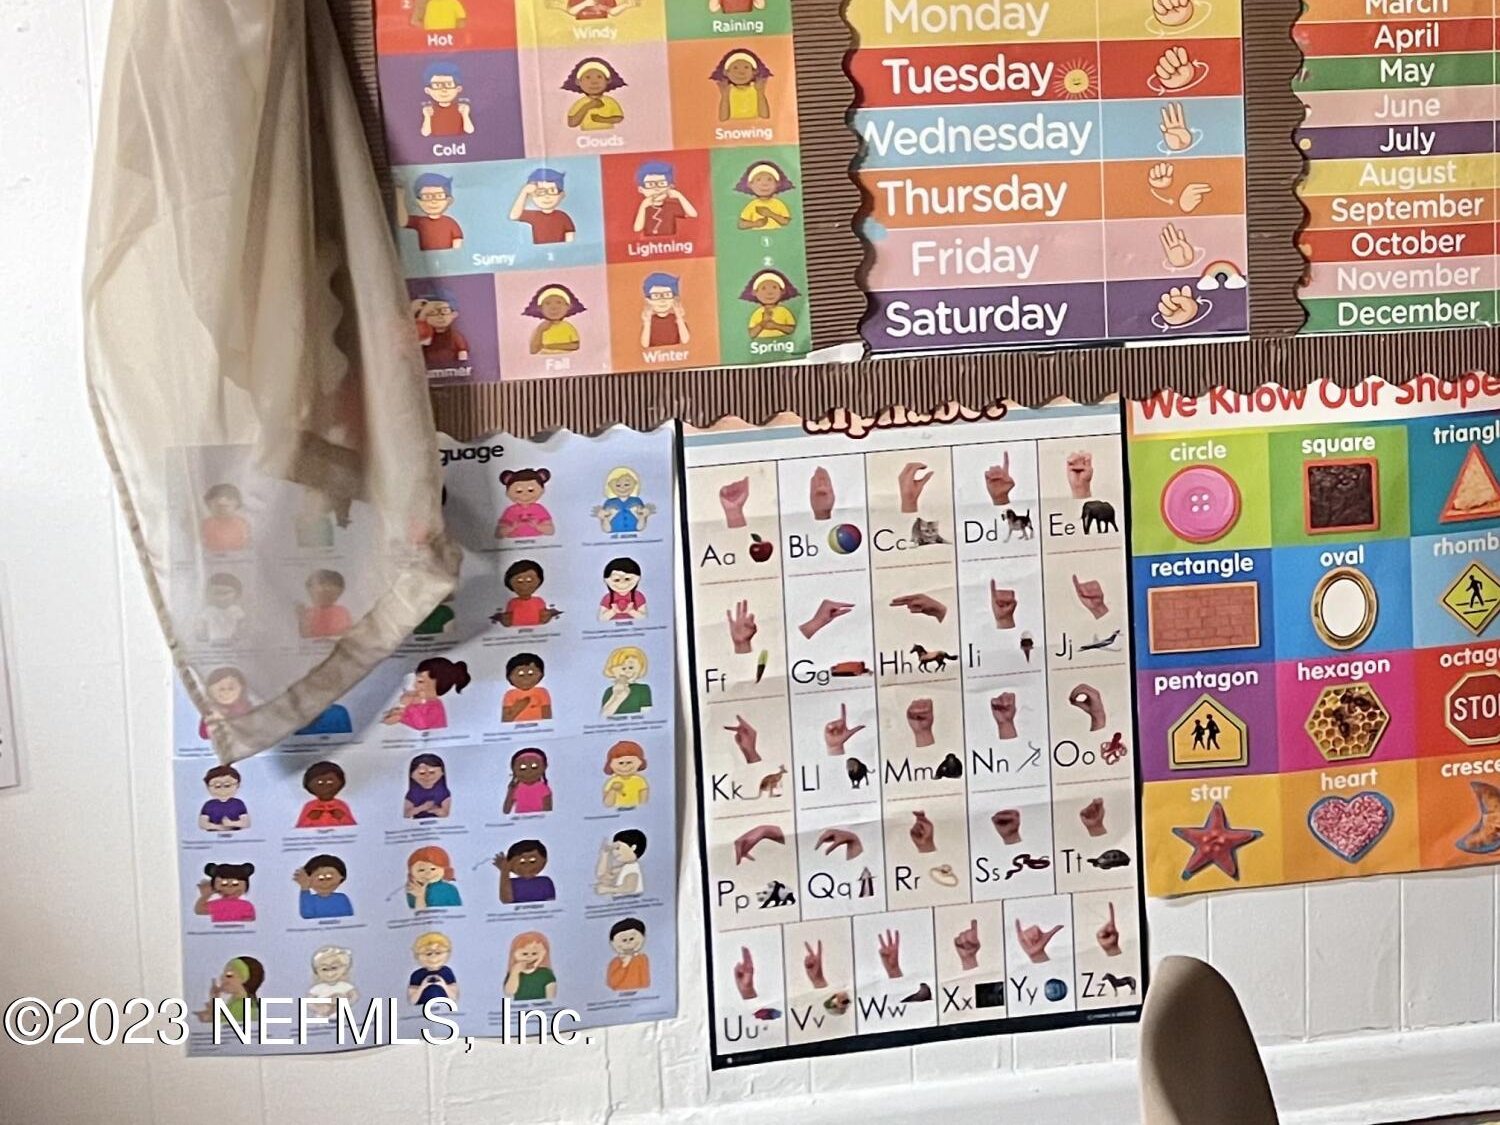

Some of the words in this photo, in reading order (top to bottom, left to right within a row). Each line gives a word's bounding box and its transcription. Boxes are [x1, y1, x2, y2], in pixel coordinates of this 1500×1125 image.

[572, 25, 617, 41] Windy
[712, 18, 763, 34] Raining
[427, 33, 453, 47] Hot
[1374, 23, 1439, 54] April
[882, 54, 1054, 97] Tuesday
[1380, 60, 1435, 86] May
[1375, 95, 1440, 119] June
[577, 134, 624, 149] Clouds
[715, 126, 773, 142] Snowing
[864, 113, 1092, 156] Wednesday
[1380, 128, 1435, 154] July
[432, 143, 466, 156] Cold
[1359, 162, 1456, 188] August
[877, 175, 1067, 216] Thursday
[1331, 195, 1483, 226] September
[628, 240, 693, 256] Lightning
[1351, 231, 1465, 257] October
[472, 252, 514, 267] Sunny
[912, 238, 1039, 276] Friday
[1337, 266, 1480, 291] November
[885, 297, 1067, 336] Saturday
[1338, 298, 1480, 327] December
[642, 348, 689, 363] Winter
[750, 339, 794, 355] Spring
[545, 357, 570, 370] Fall
[1140, 390, 1197, 421] We
[1209, 388, 1304, 415] Know
[1319, 379, 1383, 410] Our
[1170, 442, 1227, 461] circle
[1302, 435, 1376, 456] square
[964, 520, 997, 543] Dd
[1049, 514, 1075, 536] Ee
[790, 535, 818, 558] Bb
[874, 530, 907, 552] Cc
[701, 546, 735, 568] Aa
[1151, 554, 1253, 577] rectangle
[1320, 546, 1364, 567] oval
[968, 644, 981, 668] Ii
[1055, 633, 1073, 660] Jj
[791, 660, 829, 686] Gg
[880, 653, 912, 675] Hh
[1297, 658, 1390, 681] hexagon
[705, 668, 726, 692] Ff
[1155, 668, 1259, 695] pentagon
[972, 749, 1009, 773] Nn
[1054, 740, 1095, 766] Oo
[802, 765, 820, 792] Ll
[885, 760, 936, 783] Mm
[1320, 770, 1378, 790] heart
[712, 774, 743, 801] Kk
[1190, 783, 1231, 802] star
[976, 857, 999, 882] Ss
[1061, 849, 1082, 874] Tt
[808, 872, 851, 899] Qq
[896, 866, 920, 890] Rr
[718, 881, 749, 913] Pp
[1011, 976, 1038, 1004] Yy
[1082, 973, 1105, 998] Zz
[859, 995, 906, 1021] Ww
[943, 986, 972, 1012] Xx
[724, 1016, 759, 1042] Uu
[791, 1007, 824, 1030] Vv
